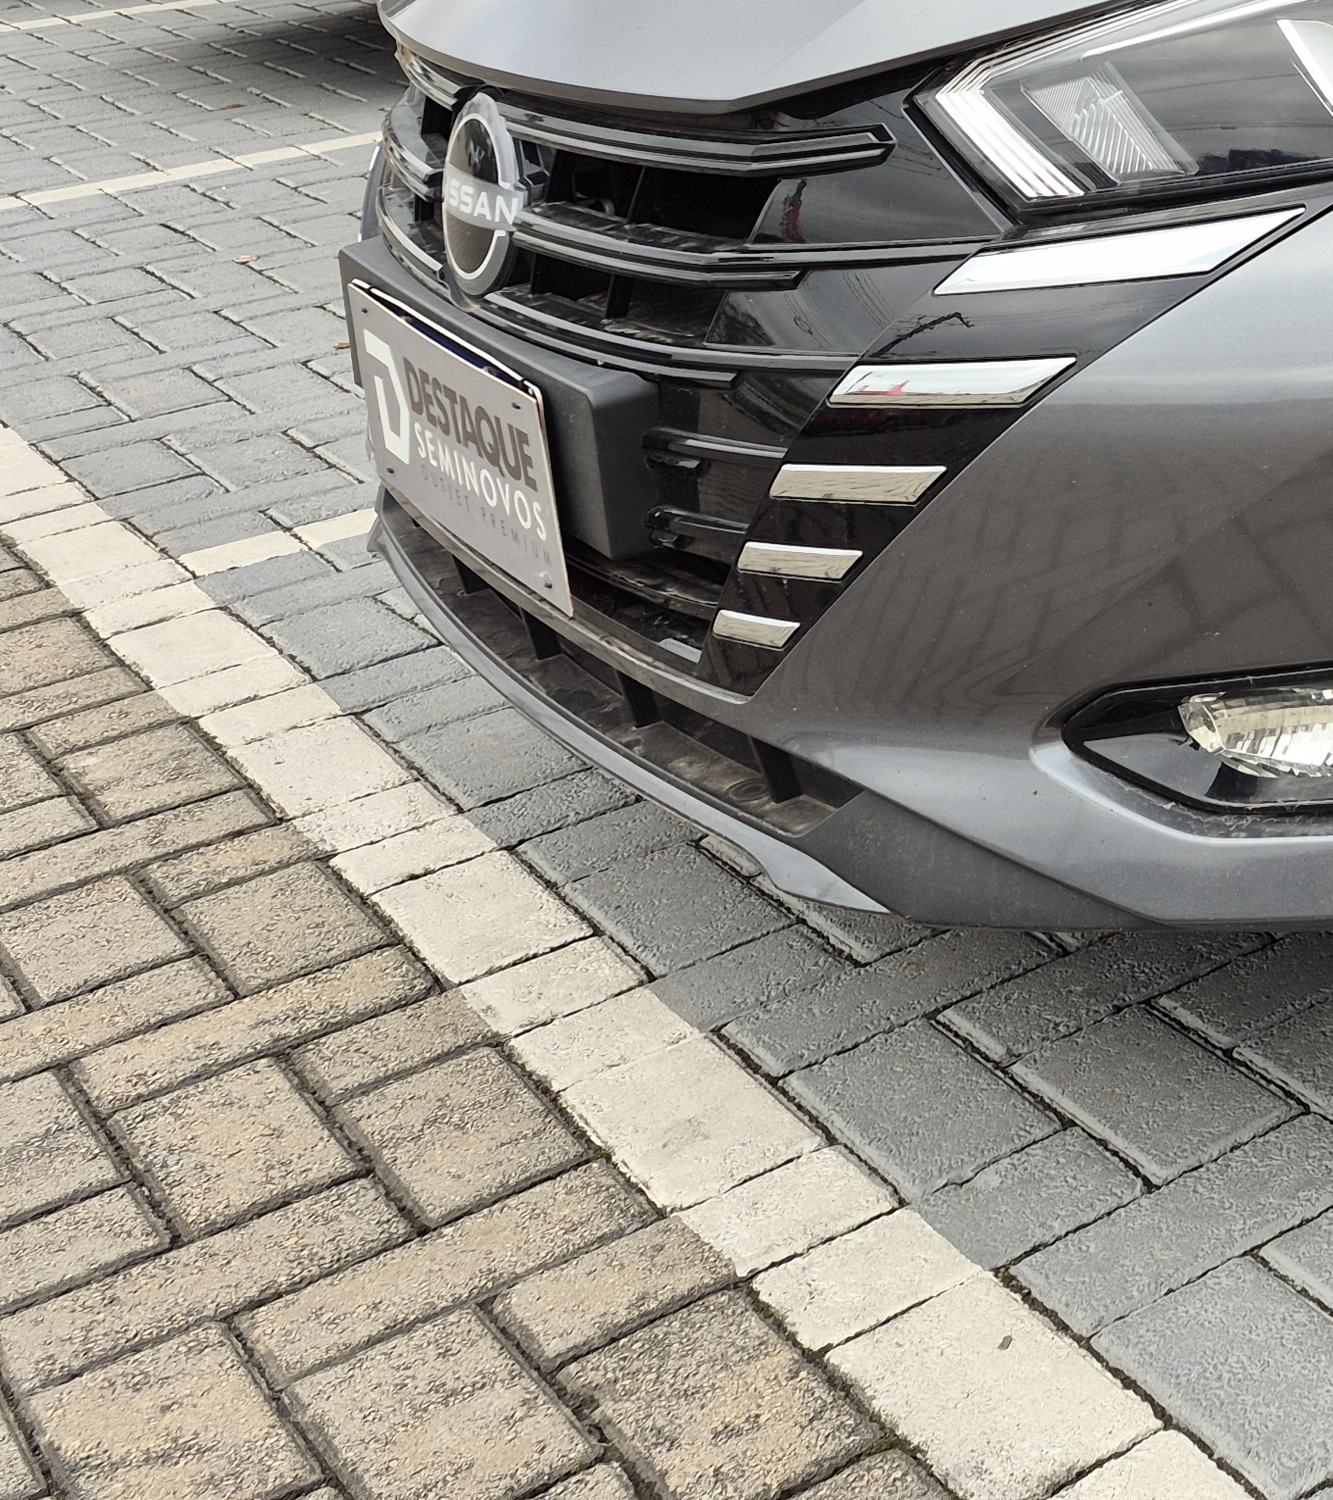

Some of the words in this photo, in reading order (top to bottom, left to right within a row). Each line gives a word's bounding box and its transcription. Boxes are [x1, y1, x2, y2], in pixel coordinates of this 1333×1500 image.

[447, 178, 519, 225] SSAN
[402, 356, 539, 493] DESTAQUE
[413, 421, 548, 542] SEMINOVOS
[420, 463, 471, 513] OUTLET
[480, 506, 552, 569] PREMIUM
